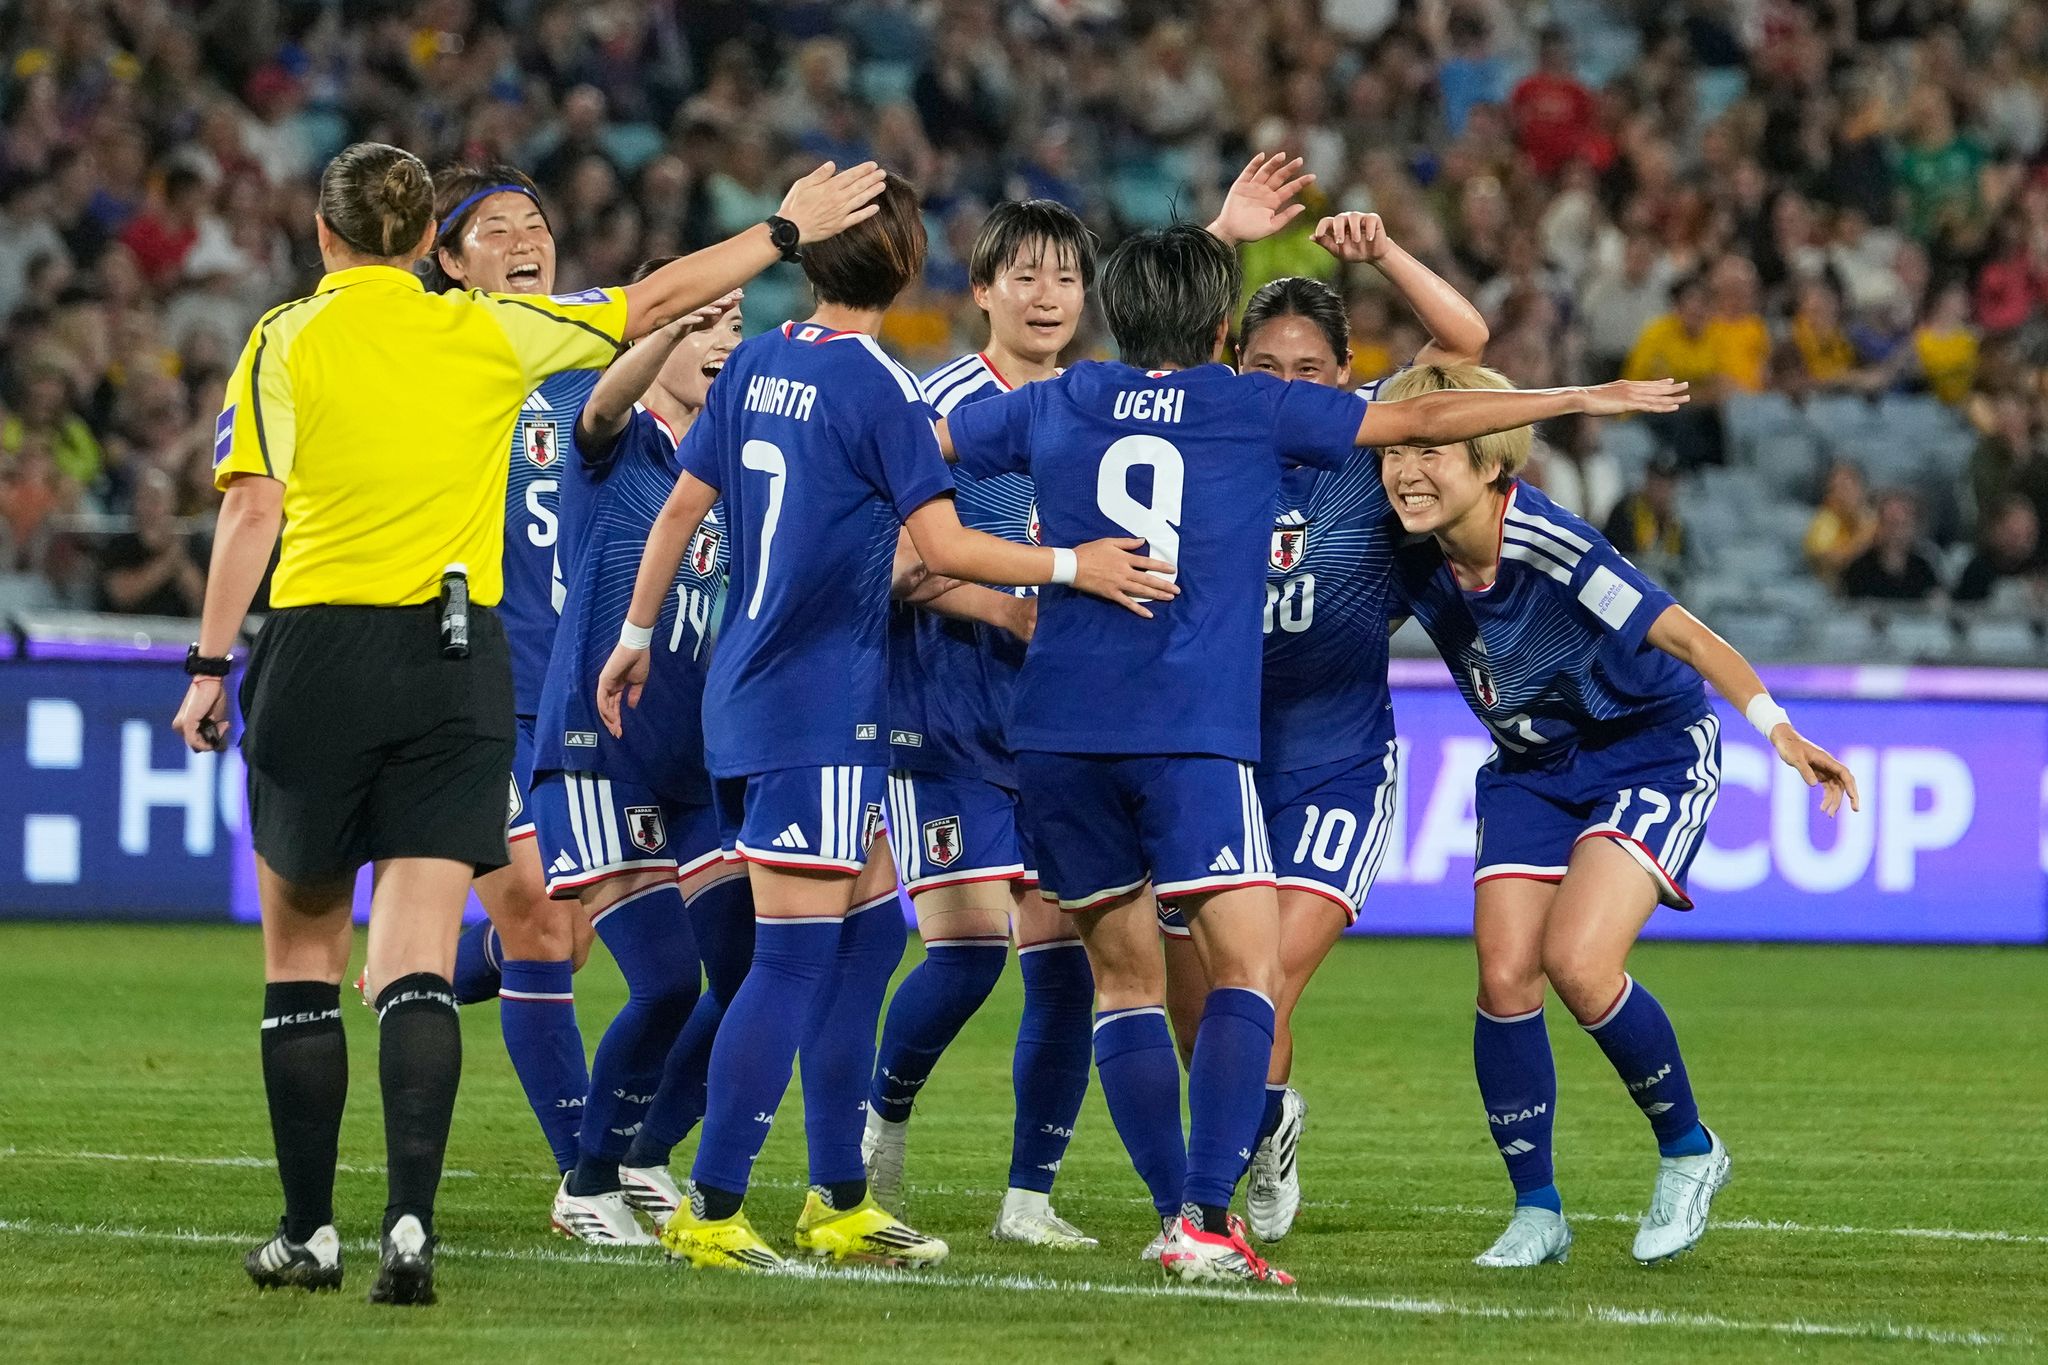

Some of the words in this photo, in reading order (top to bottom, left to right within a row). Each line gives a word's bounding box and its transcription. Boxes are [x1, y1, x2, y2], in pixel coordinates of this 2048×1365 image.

[744, 374, 818, 422] HINATA
[1113, 387, 1185, 424] UEKI
[741, 438, 787, 621] 7
[1598, 583, 1617, 608] DREAM
[1599, 583, 1624, 615] FEARLESS
[668, 583, 710, 662] 14
[931, 819, 951, 828] JAPAN
[1293, 804, 1358, 872] 10
[1607, 786, 1671, 843] 17
[1688, 742, 1976, 893] CUP
[1485, 1102, 1547, 1125] APAN
